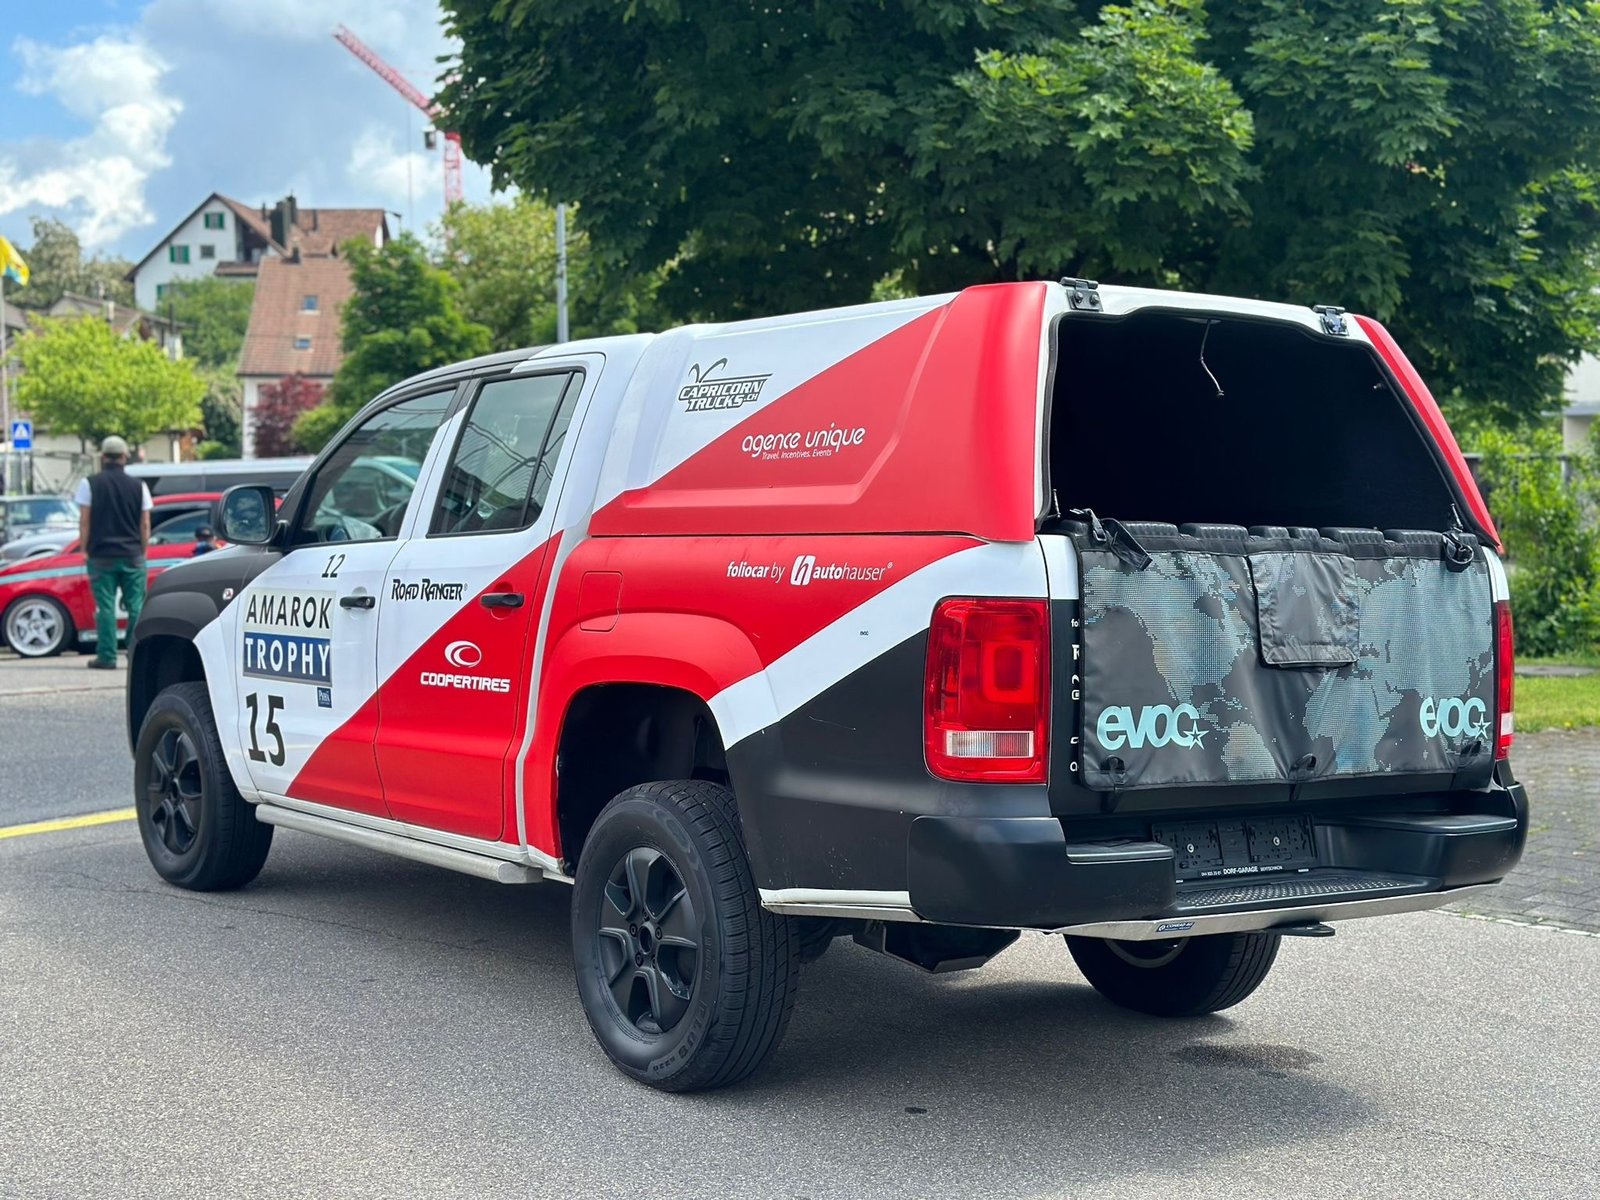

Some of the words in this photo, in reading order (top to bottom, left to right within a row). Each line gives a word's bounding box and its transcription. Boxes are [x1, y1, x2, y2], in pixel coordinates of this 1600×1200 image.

[679, 379, 764, 400] CAPRICORN
[741, 432, 800, 458] agence
[805, 422, 866, 452] unique
[812, 449, 832, 458] Events
[321, 553, 346, 579] 12
[727, 561, 769, 578] foliocar
[771, 562, 786, 583] by
[391, 578, 420, 602] ROAD
[245, 594, 333, 629] AMAROK
[245, 637, 331, 677] TROPHY
[245, 691, 286, 767] 15
[1097, 702, 1200, 751] evoc
[1222, 865, 1259, 875] DORF-GARAGE
